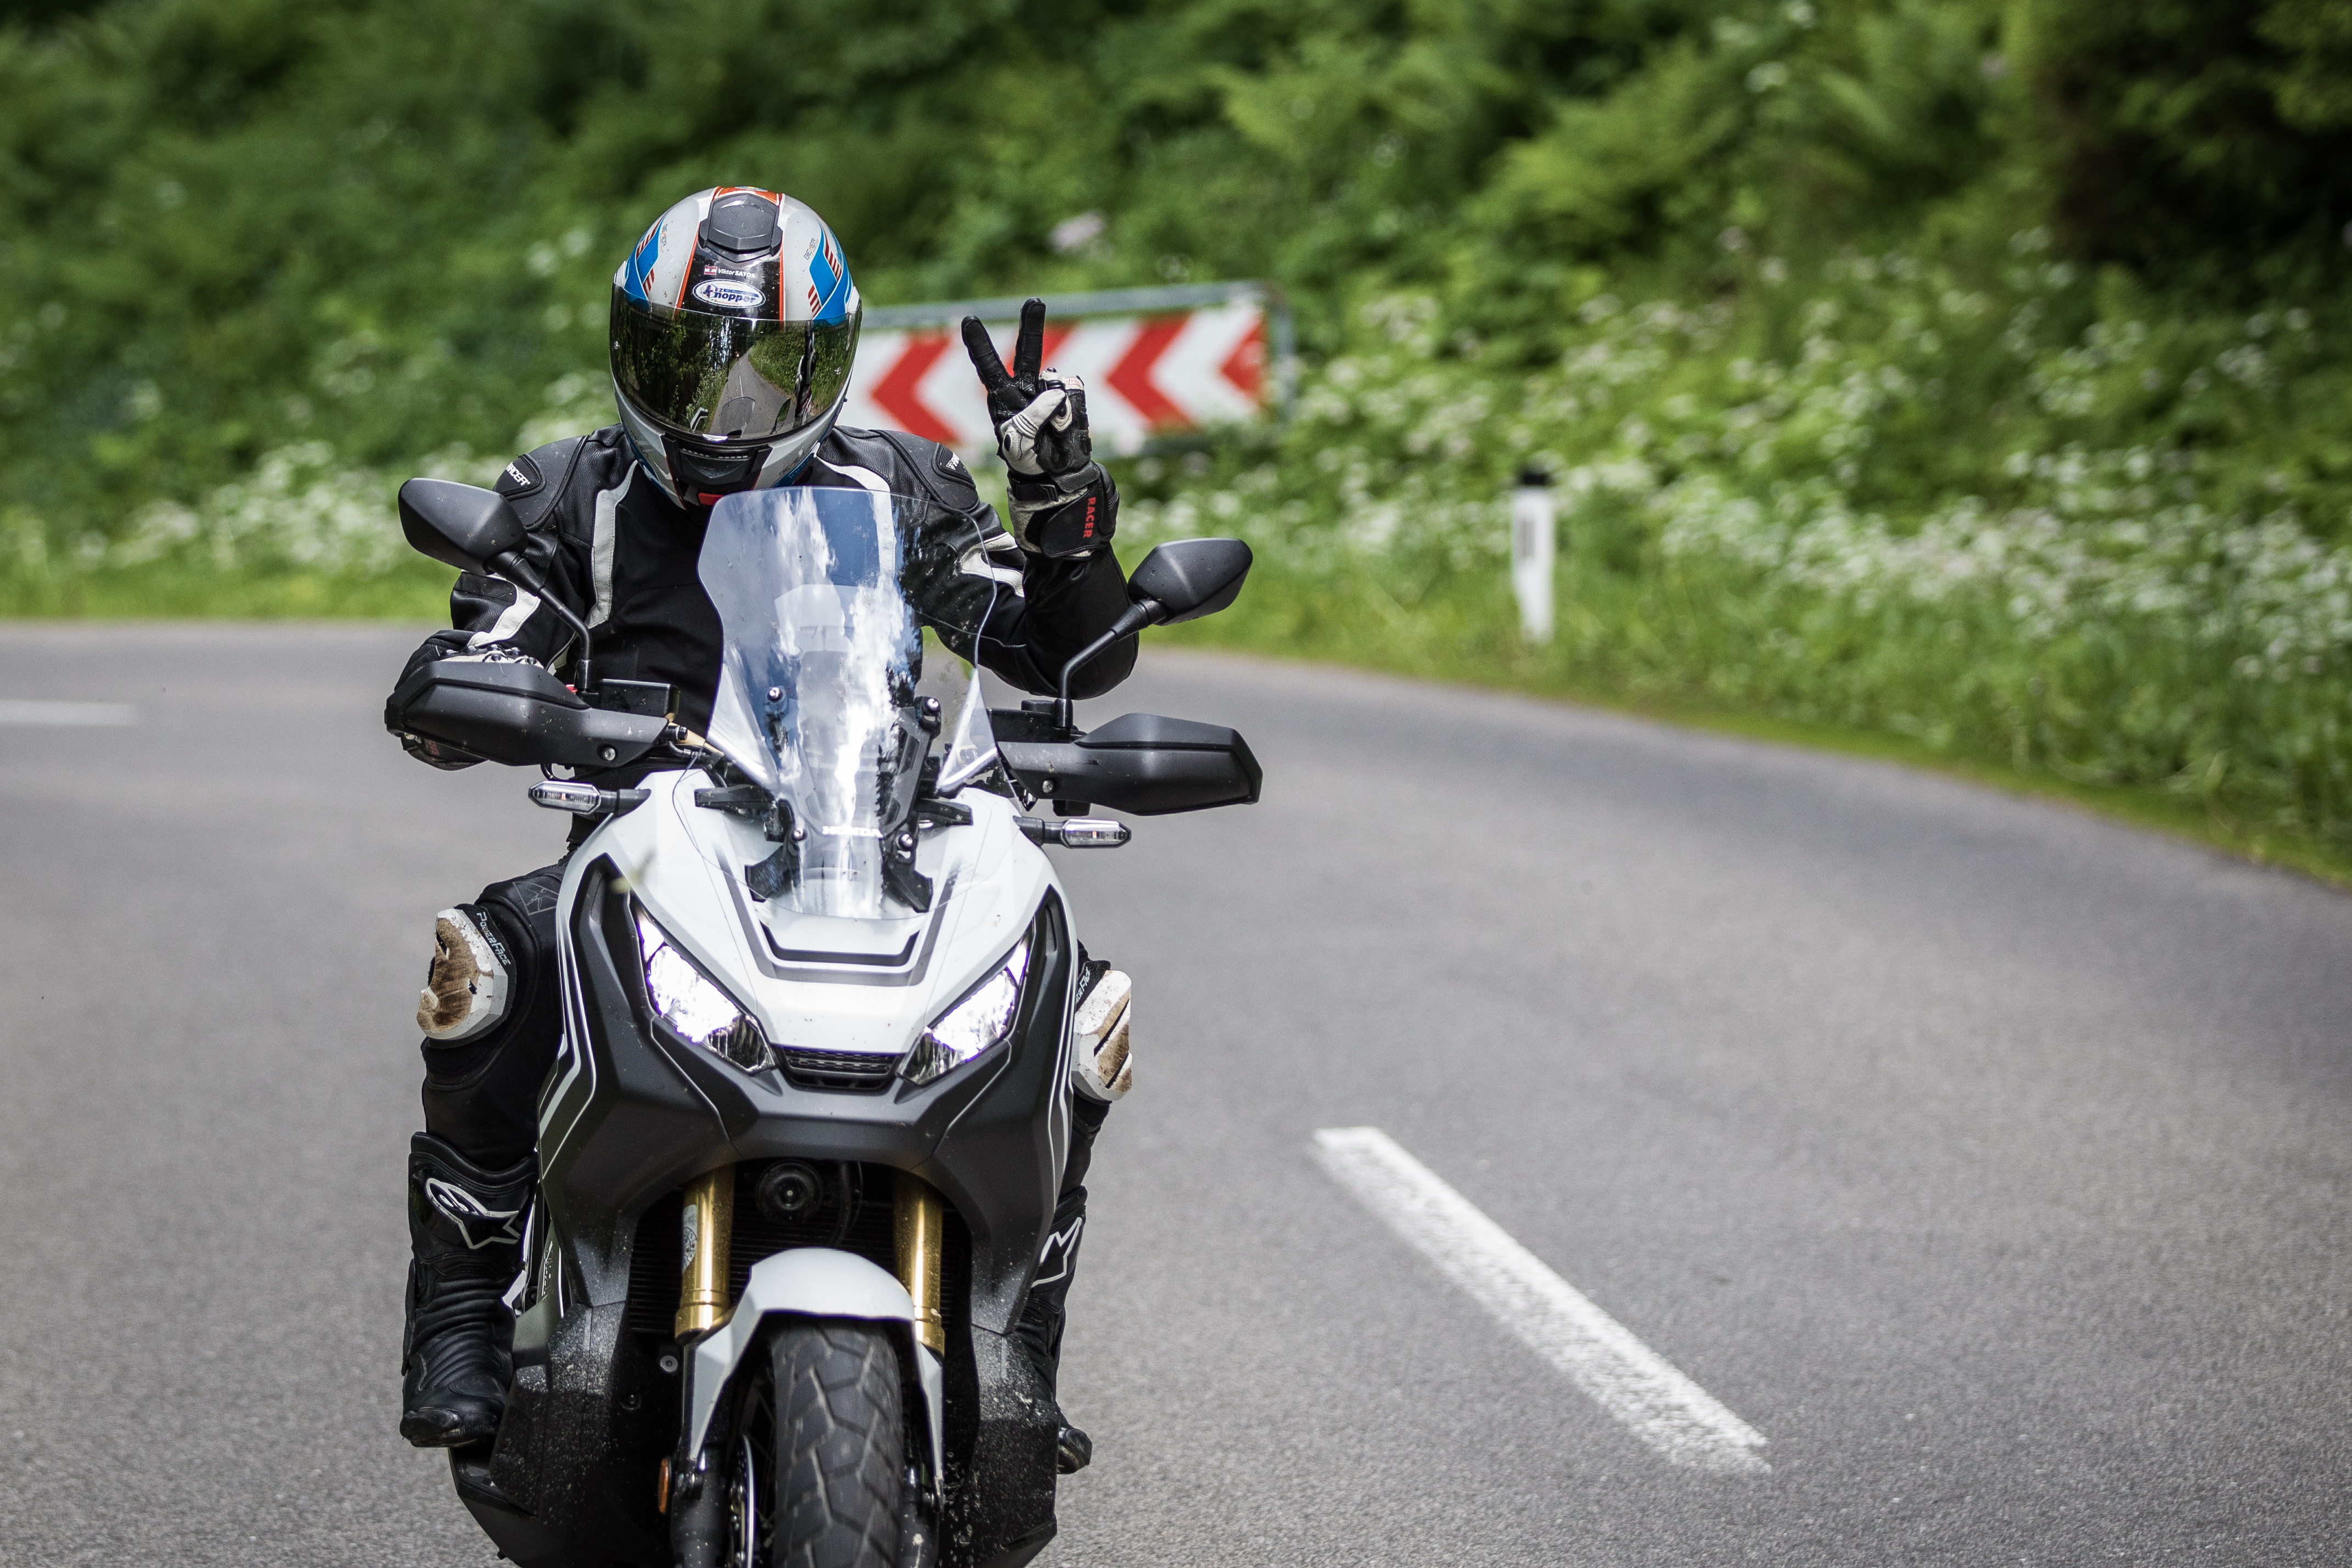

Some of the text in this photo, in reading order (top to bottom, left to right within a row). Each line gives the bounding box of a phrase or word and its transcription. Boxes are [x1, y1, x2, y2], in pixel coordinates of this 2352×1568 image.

[734, 270, 756, 279] SATOR
[1083, 497, 1096, 538] RACER
[822, 825, 884, 838] HONDA
